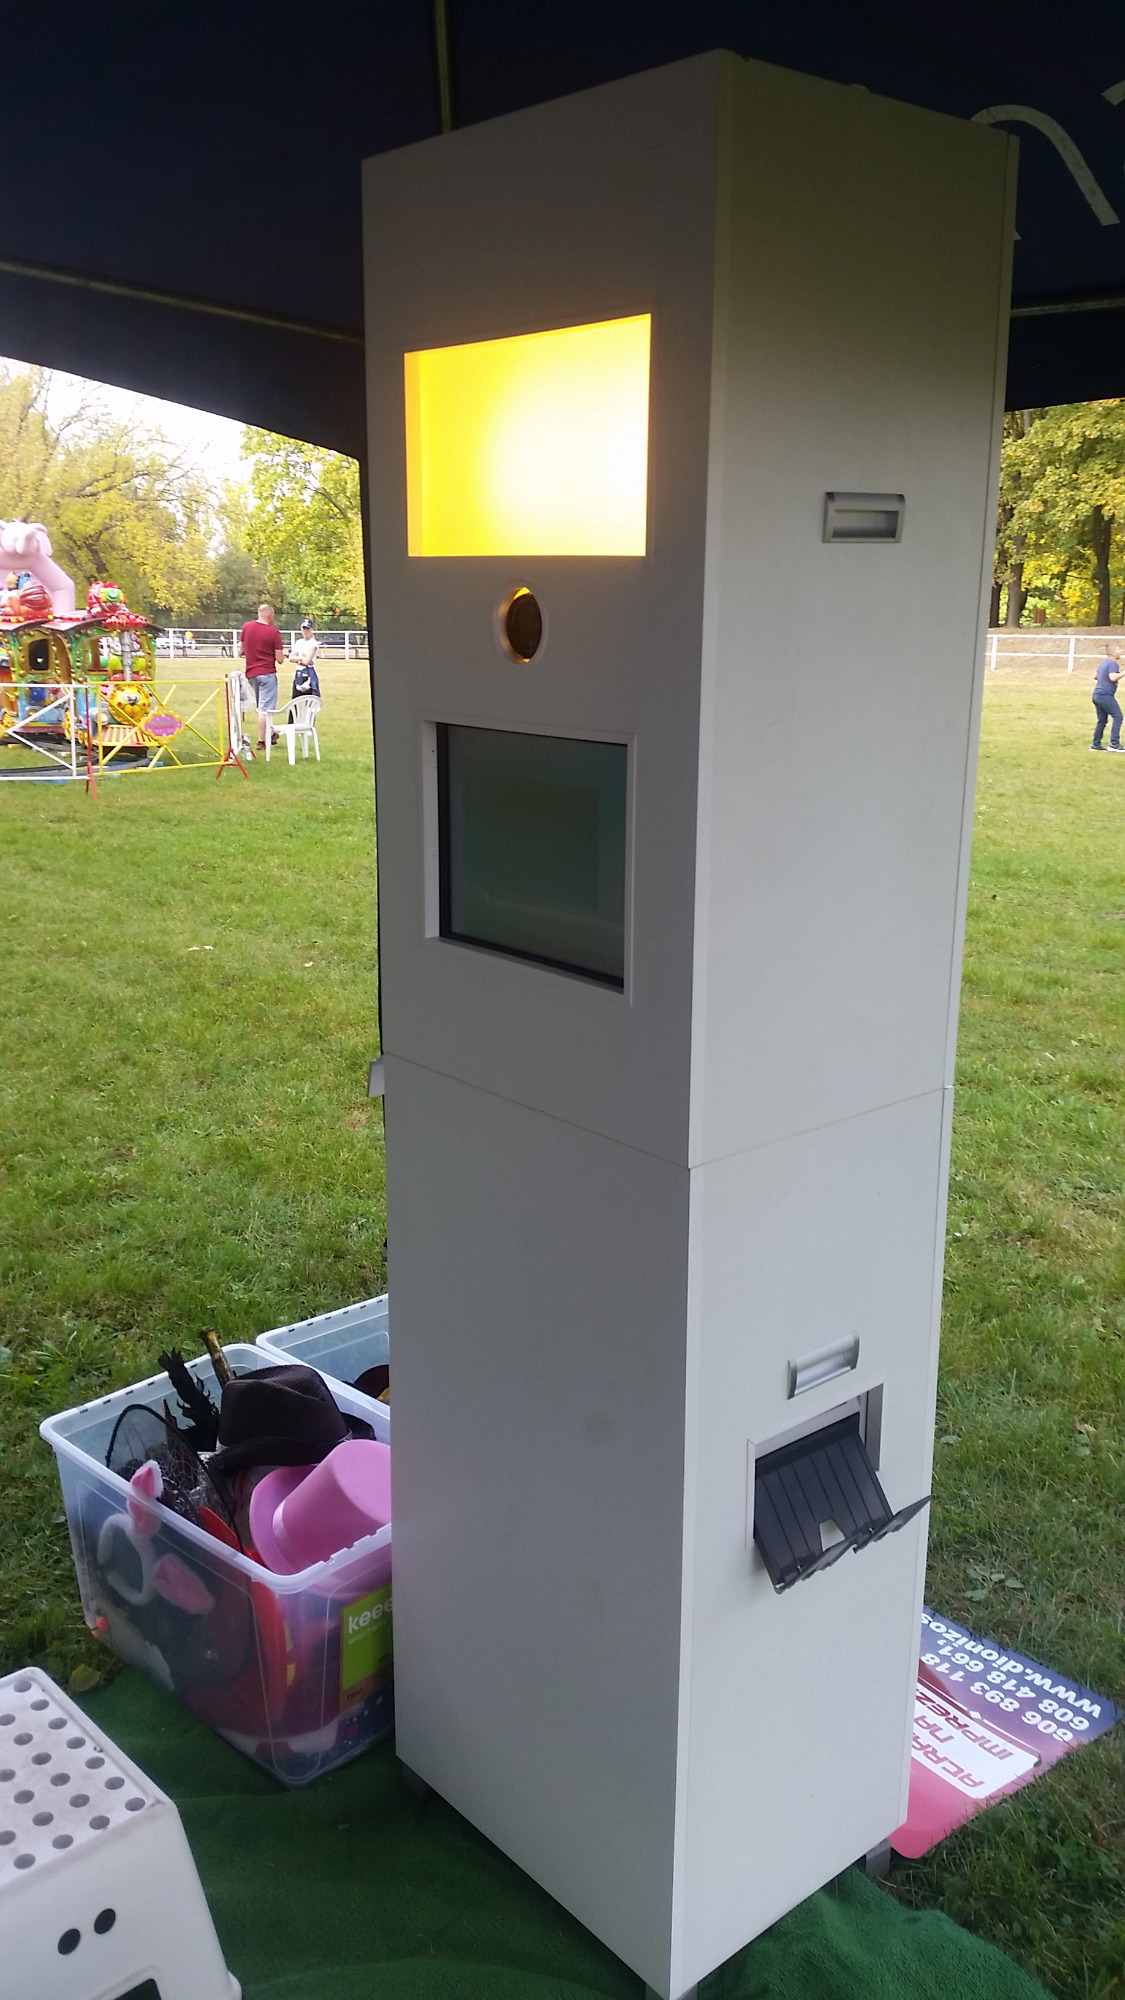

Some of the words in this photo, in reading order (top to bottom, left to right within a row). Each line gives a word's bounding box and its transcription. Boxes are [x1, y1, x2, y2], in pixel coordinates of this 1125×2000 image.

[921, 1653, 965, 1682] 118
[970, 1682, 1020, 1712] 893
[987, 1671, 1036, 1698] 418
[914, 1715, 955, 1743] NA
[916, 1689, 1019, 1760] IMPREZ
[1021, 1711, 1073, 1742] 606
[1038, 1699, 1090, 1731] 608
[912, 1733, 985, 1788] ATRA
